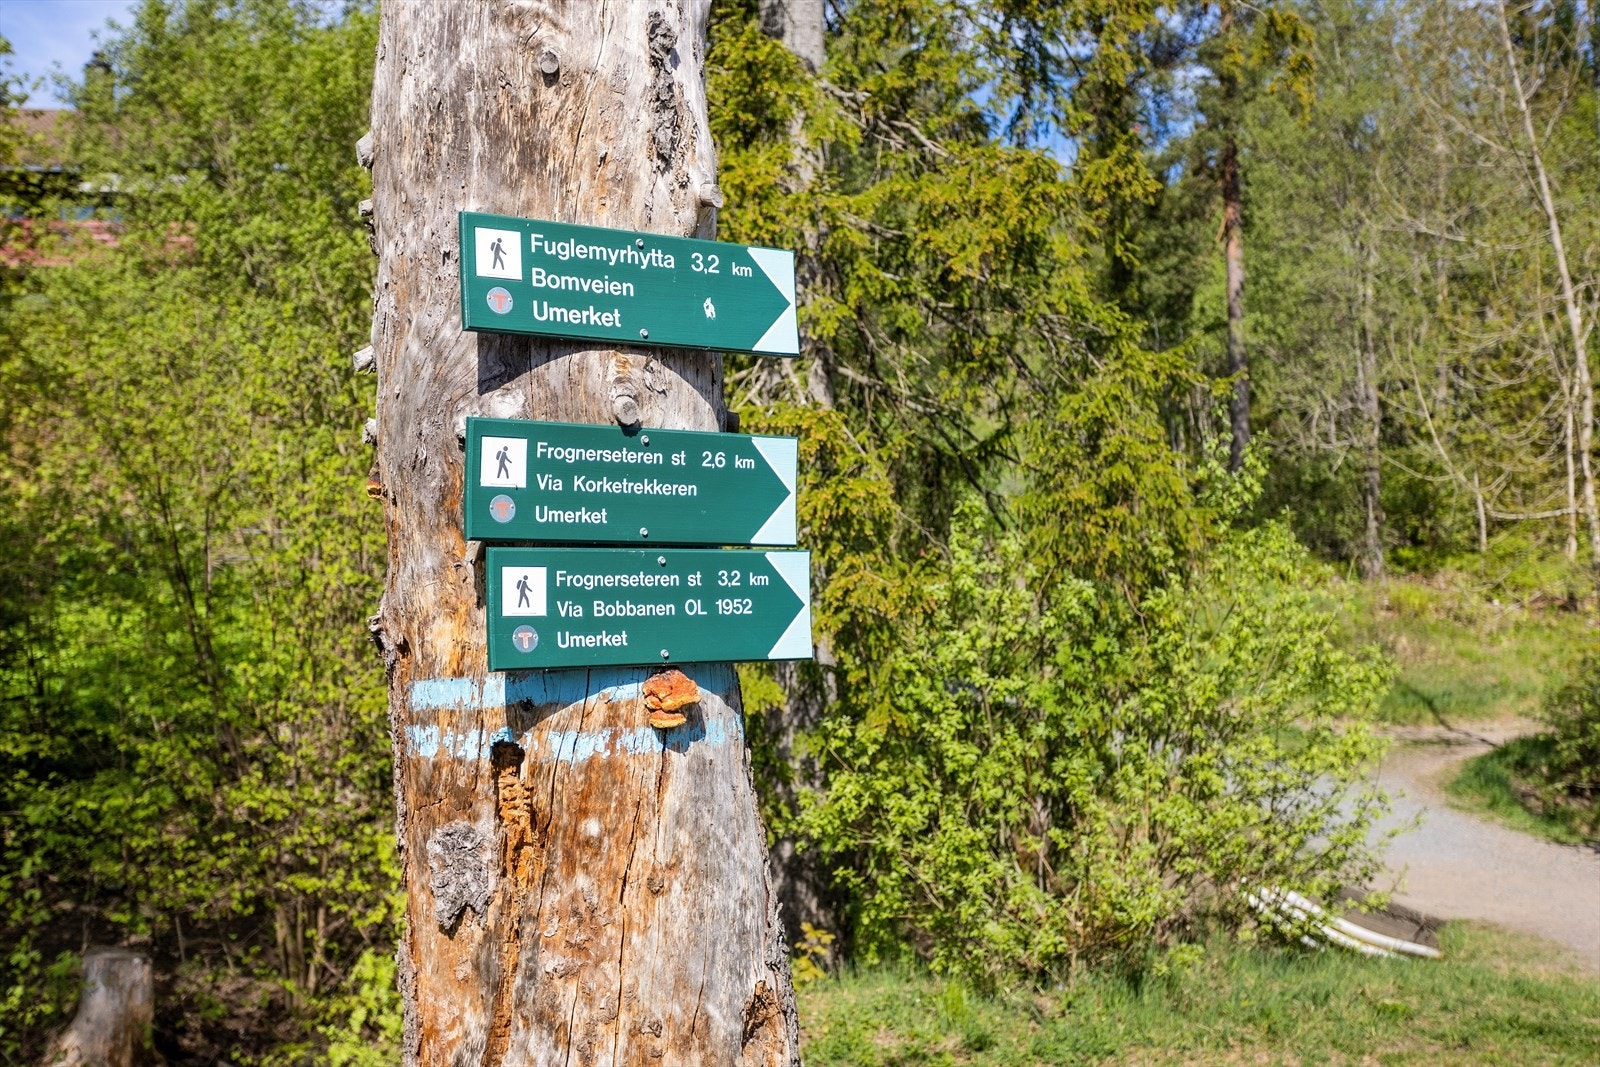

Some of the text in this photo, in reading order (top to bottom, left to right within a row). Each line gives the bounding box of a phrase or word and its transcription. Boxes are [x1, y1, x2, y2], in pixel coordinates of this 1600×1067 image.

[531, 233, 752, 277] Fuglemyrhytta 3,2 km
[532, 267, 634, 296] Bomveien
[533, 300, 621, 327] Umerket
[537, 442, 754, 469] Frognerseteren st 2,6 km
[537, 474, 697, 496] Via Korketrekkeren
[536, 506, 607, 523] Umerket
[557, 571, 768, 590] Frognerseteren st 3,2 km
[557, 599, 752, 617] Via Bobbanen OL 1952
[558, 631, 627, 648] Umerket
